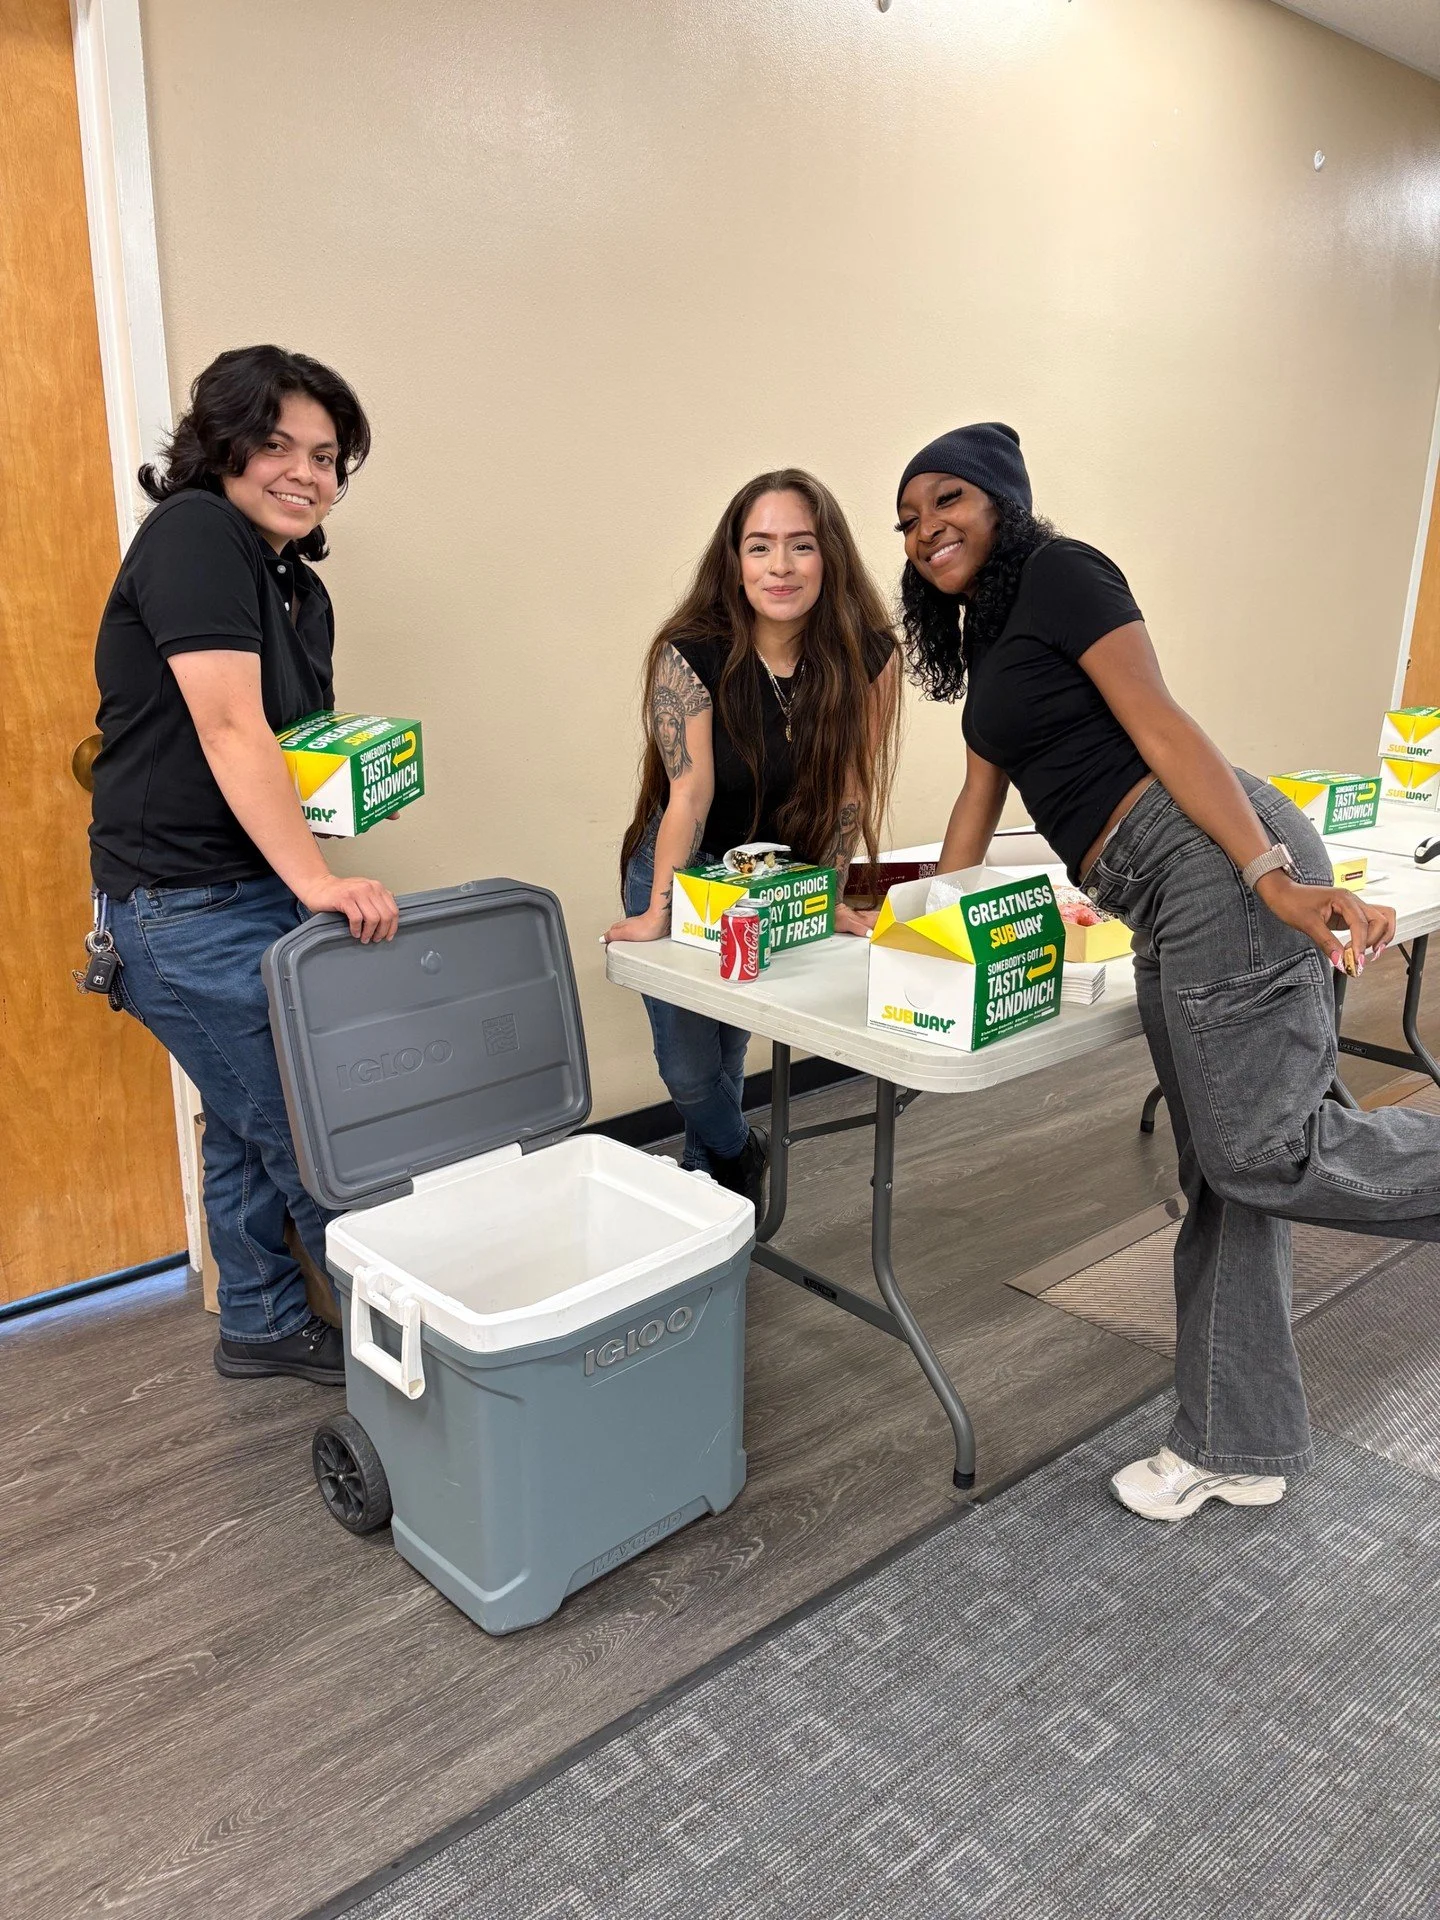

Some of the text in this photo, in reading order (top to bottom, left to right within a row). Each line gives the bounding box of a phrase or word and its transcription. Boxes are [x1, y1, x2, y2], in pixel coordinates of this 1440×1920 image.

[392, 735, 401, 749] GOT
[1387, 744, 1432, 757] SUBWAY
[361, 752, 392, 787] TASTY
[363, 761, 418, 811] SANDWICH
[1335, 792, 1357, 808] TASTY
[1386, 788, 1432, 801] SUBWAY
[1332, 803, 1374, 822] SANDWICH
[759, 875, 829, 904] GOOD CHOICE
[770, 900, 803, 923] AY TO
[968, 885, 1053, 927] GREATNESS
[682, 921, 721, 943] SUBWA
[770, 925, 784, 948] AT
[785, 913, 828, 944] FRESH
[990, 913, 1044, 949] SUBWAY
[987, 953, 1026, 976] SOMEBODY'S
[1026, 948, 1039, 962] GOT
[987, 966, 1026, 1000] TASTY
[985, 977, 1056, 1026] SANDWICH
[881, 1005, 956, 1034] SUBWAY
[336, 1039, 454, 1092] IGLOO
[584, 1306, 693, 1377] IGLOO
